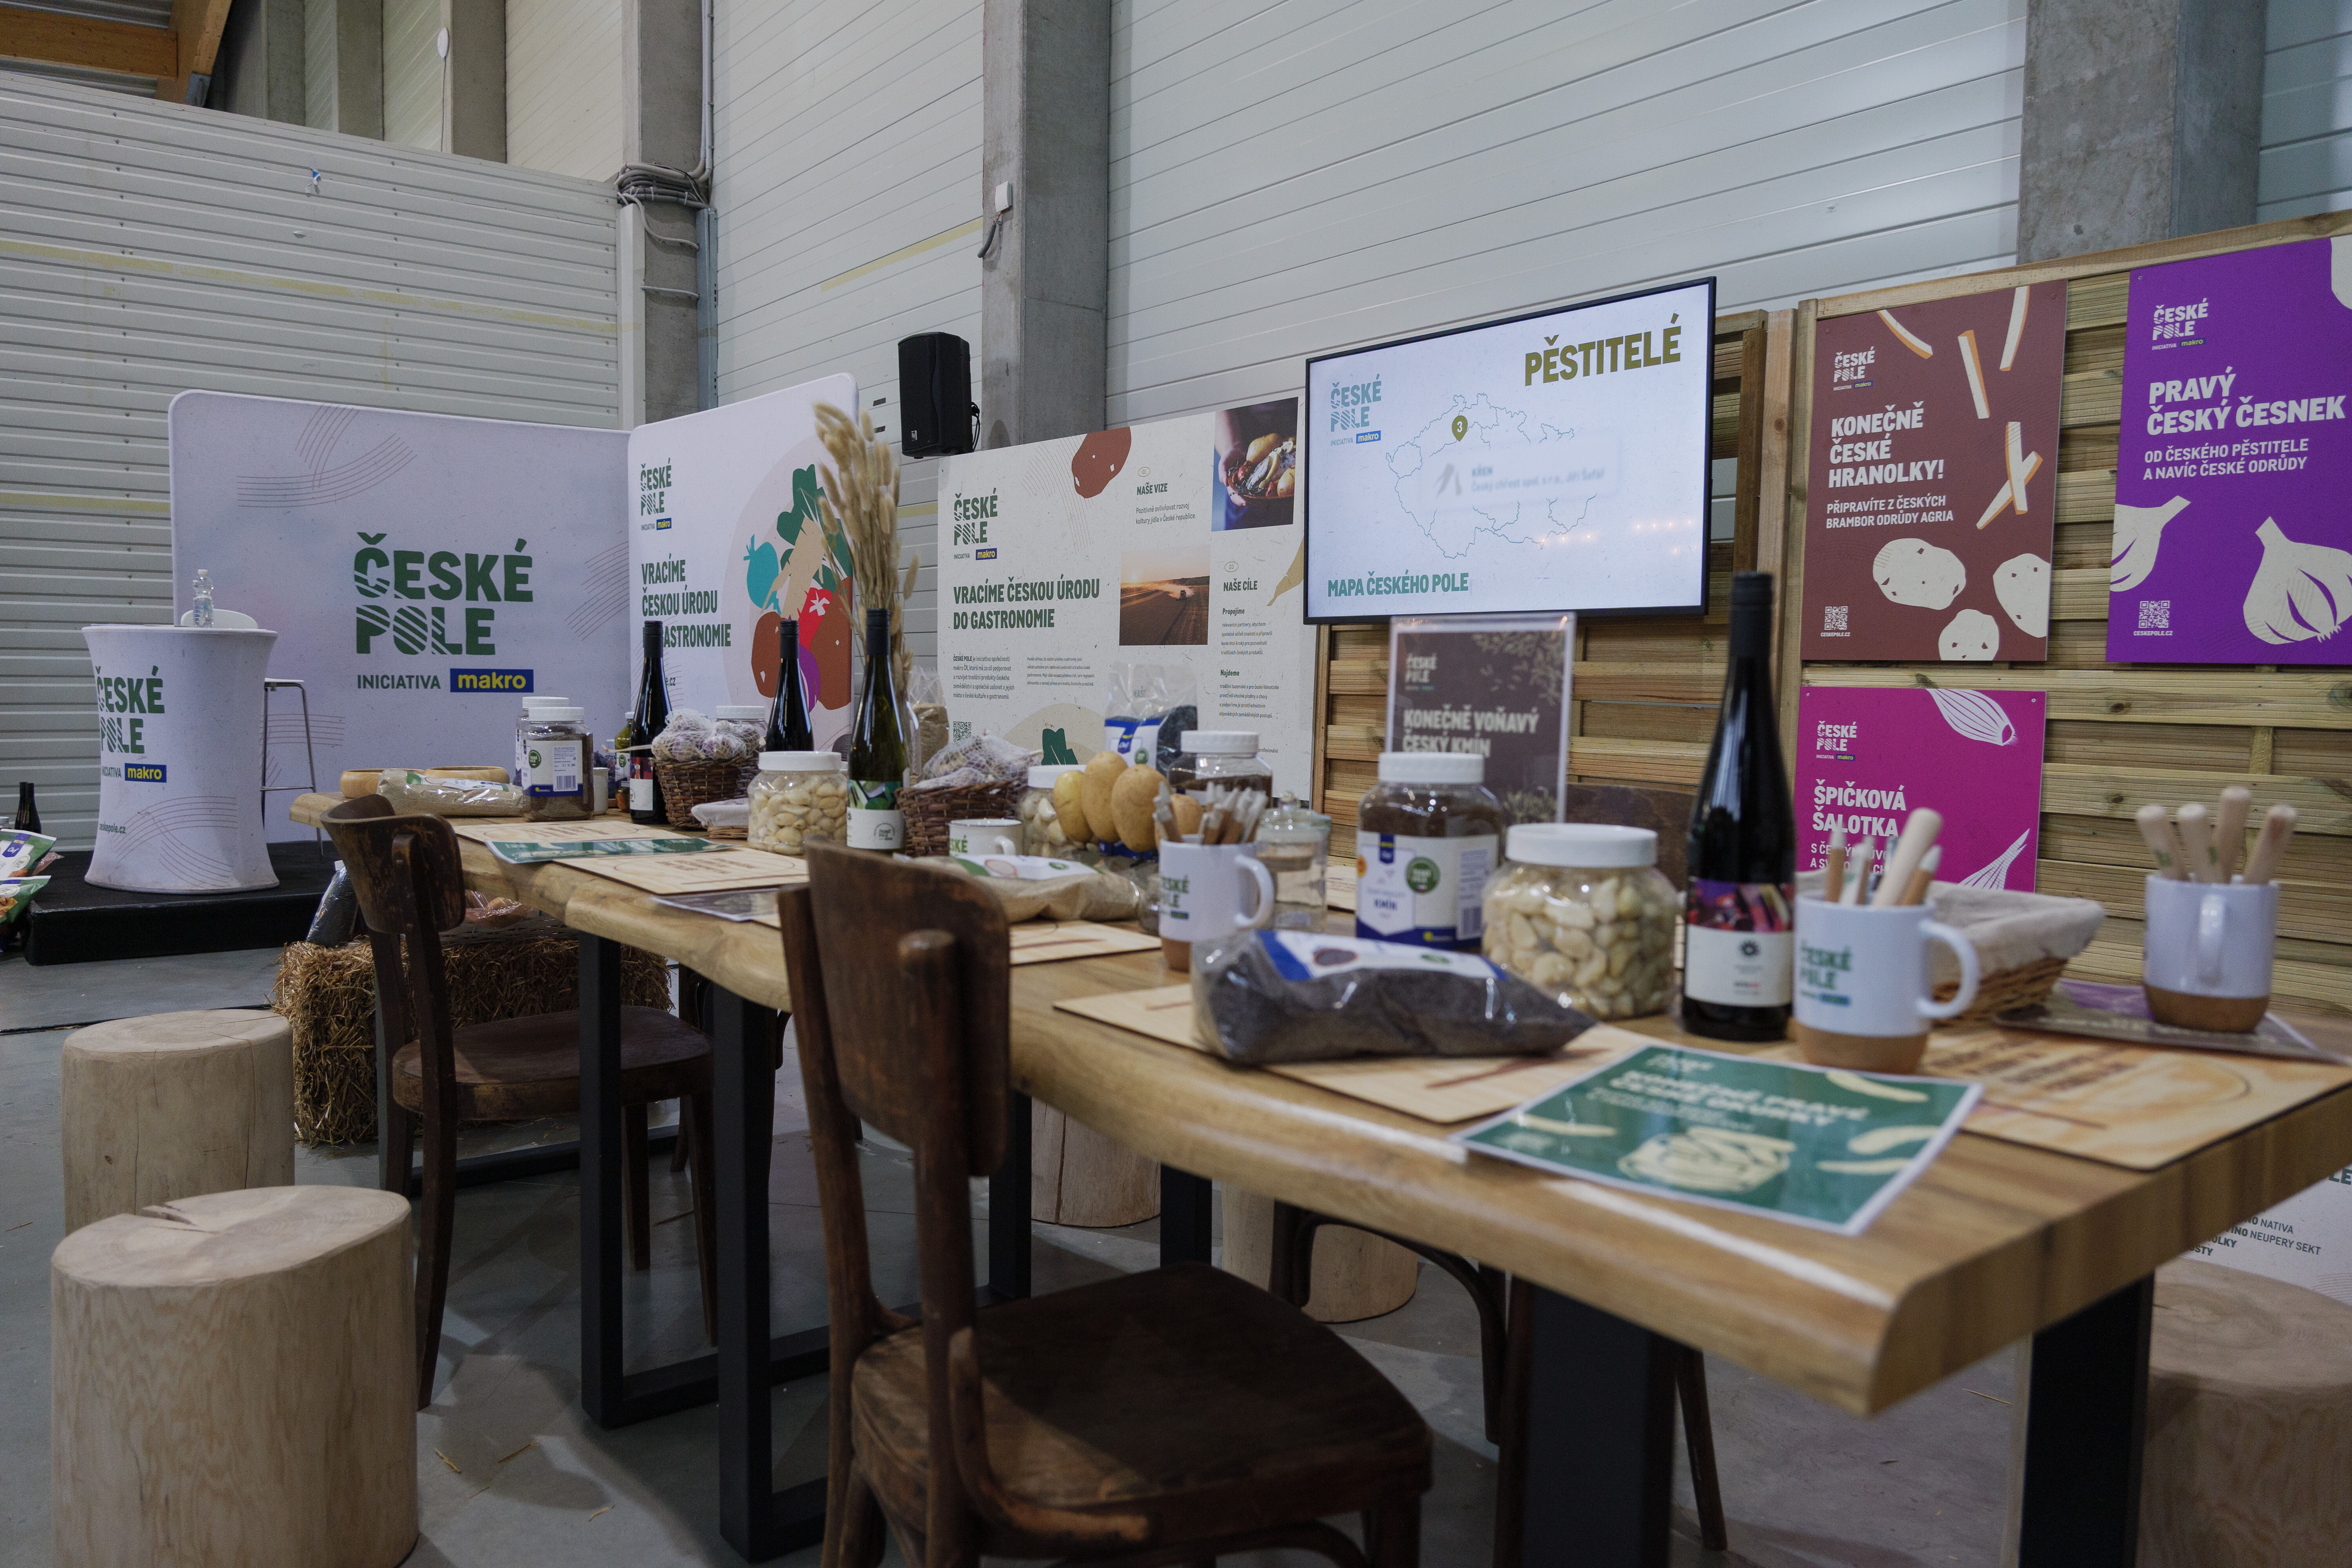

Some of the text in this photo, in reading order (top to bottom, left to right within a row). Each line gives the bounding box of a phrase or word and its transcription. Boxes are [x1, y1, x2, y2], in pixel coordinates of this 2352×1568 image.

[2153, 298, 2209, 324] ČESKÉ
[2152, 321, 2195, 341] POLE
[1525, 313, 1681, 386] PĚSTITELÉ
[1835, 346, 1875, 368] ČESKÉ
[1834, 366, 1865, 382] POLE
[2149, 366, 2236, 405] PRAVÝ
[1331, 374, 1381, 408] ČESKÉ
[1331, 406, 1369, 432] POLE
[1457, 421, 1463, 432] 3
[1831, 401, 1924, 437] KONEČNĚ
[2147, 395, 2346, 436] ČESKÝ ČESNEK
[1330, 433, 1379, 446] INICIATIVA makro
[1830, 433, 1891, 464] ČESKÉ
[2145, 438, 2309, 463] OD ČESKÉHO PĚSTITELE
[641, 457, 671, 491] ČESKÉ
[1829, 459, 1944, 488] HRANOLKY!
[2143, 454, 2308, 480] A NAVÍC ČESKÉ ODRŮDY
[1137, 482, 1168, 495] NAŠE VIZE
[641, 491, 664, 515] POLE
[954, 487, 998, 521] ČESKÉ
[1136, 506, 1154, 514] Pozitivně
[1827, 493, 1946, 514] PŘIPRAVÍTE Z ČESKÝCH
[657, 520, 671, 529] makro
[1150, 516, 1159, 524] jídla
[1163, 514, 1175, 522] České
[1176, 513, 1196, 521] republice.
[1826, 510, 1953, 528] BRAMBOR ODRŮDY AGRIA
[954, 521, 987, 546] POLE
[354, 532, 534, 602] ČESKÉ
[977, 550, 995, 559] makro
[641, 553, 686, 584] VRACÍME
[953, 573, 1100, 604] VRACÍME ČESKOU ÚRODU
[1223, 577, 1258, 591] NAŠE CÍLE
[1328, 569, 1468, 597] MAPA ČESKÉHO POLE
[642, 584, 718, 617] ČESKOU ÚRODU
[1223, 608, 1245, 616] Propojíme
[356, 605, 495, 655] POLE
[953, 608, 1054, 630] DO GASTRONOMIE
[663, 624, 731, 648] ASTRONOMIE
[95, 665, 165, 713] ČESKÉ
[357, 672, 526, 689] INICIATIVA makro
[1133, 686, 1145, 698] NAŠ
[1403, 704, 1471, 730] KONEČNĚ
[1817, 720, 1857, 738] ČESKÉ
[100, 716, 145, 754] POLE
[1816, 738, 1847, 751] POLE
[127, 766, 162, 780] makro
[1814, 779, 1906, 811] ŠPIČKOVÁ
[1813, 805, 1898, 837] ŠALOTKA
[1811, 843, 1817, 853] S
[1810, 858, 1817, 867] A
[2260, 1218, 2294, 1234] NATIVA
[2250, 1230, 2294, 1248] NEUPERY
[2296, 1242, 2321, 1255] SEKT
